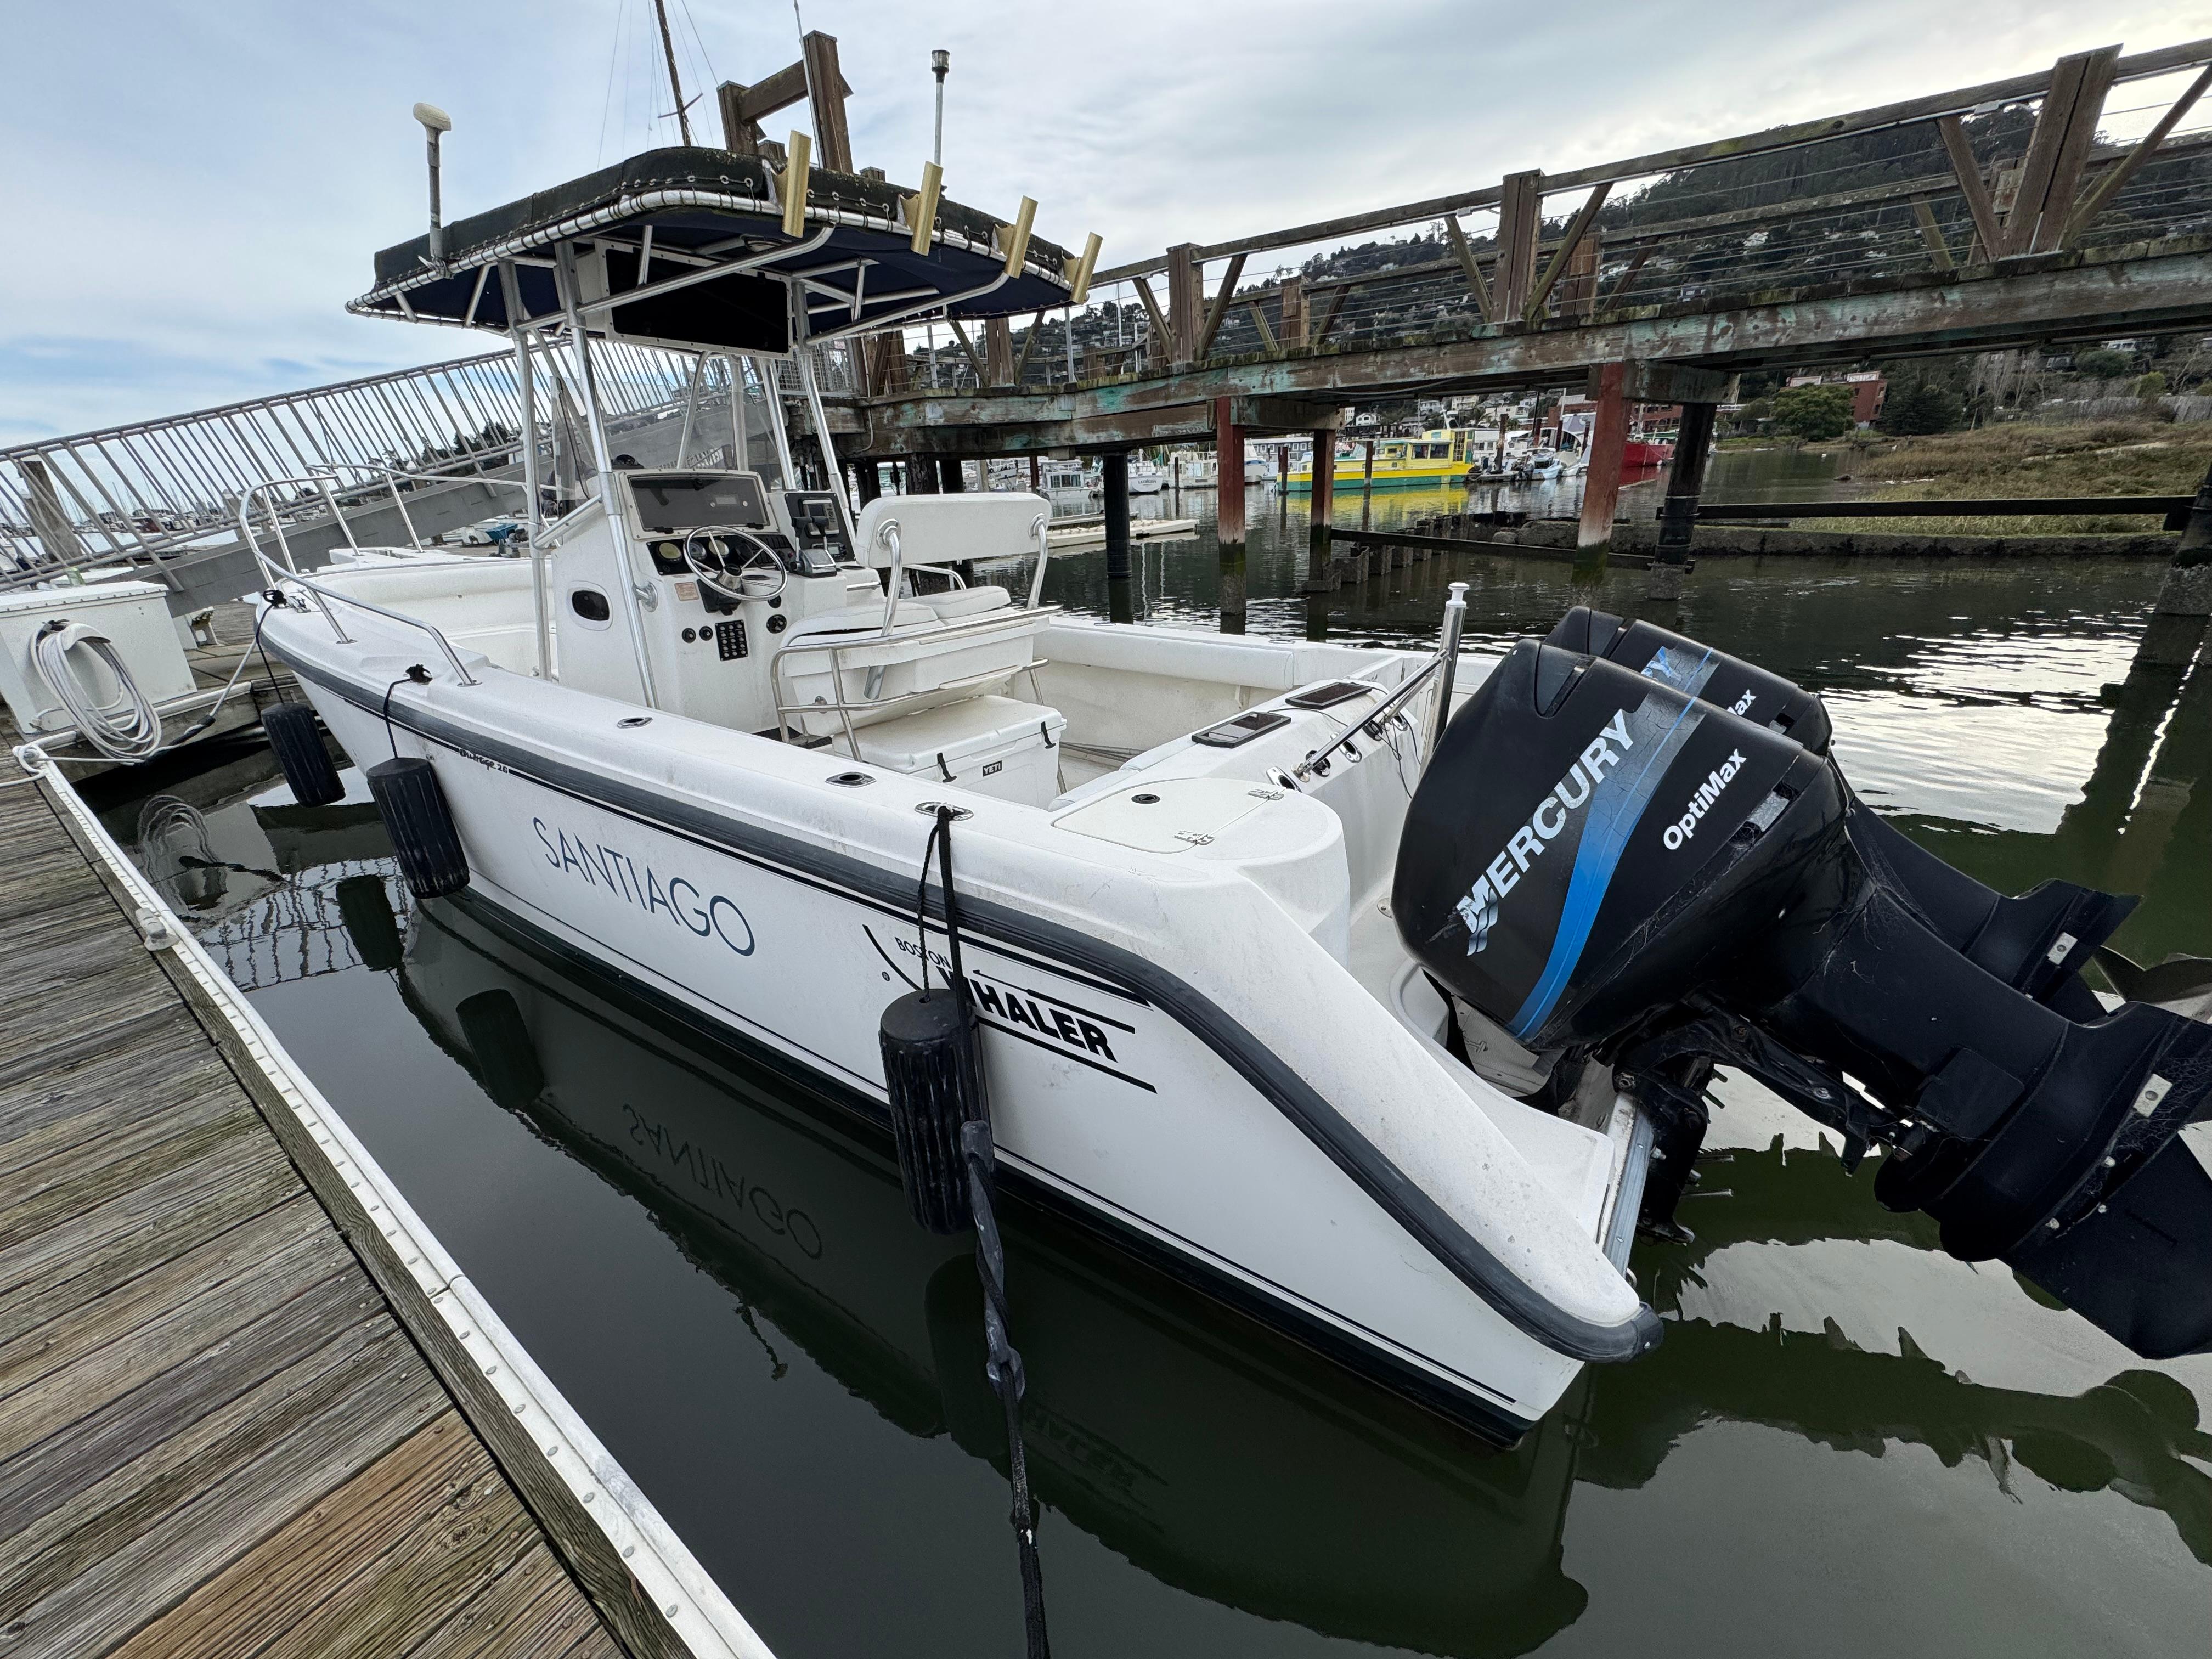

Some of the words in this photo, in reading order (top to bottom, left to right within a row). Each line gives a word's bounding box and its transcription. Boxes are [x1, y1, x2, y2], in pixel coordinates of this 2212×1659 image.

[497, 764, 508, 774] 26
[984, 763, 1001, 775] YETI
[1663, 748, 1747, 850] OptiMax
[1456, 709, 1634, 933] MERCURY
[533, 817, 755, 957] SANTIAGO
